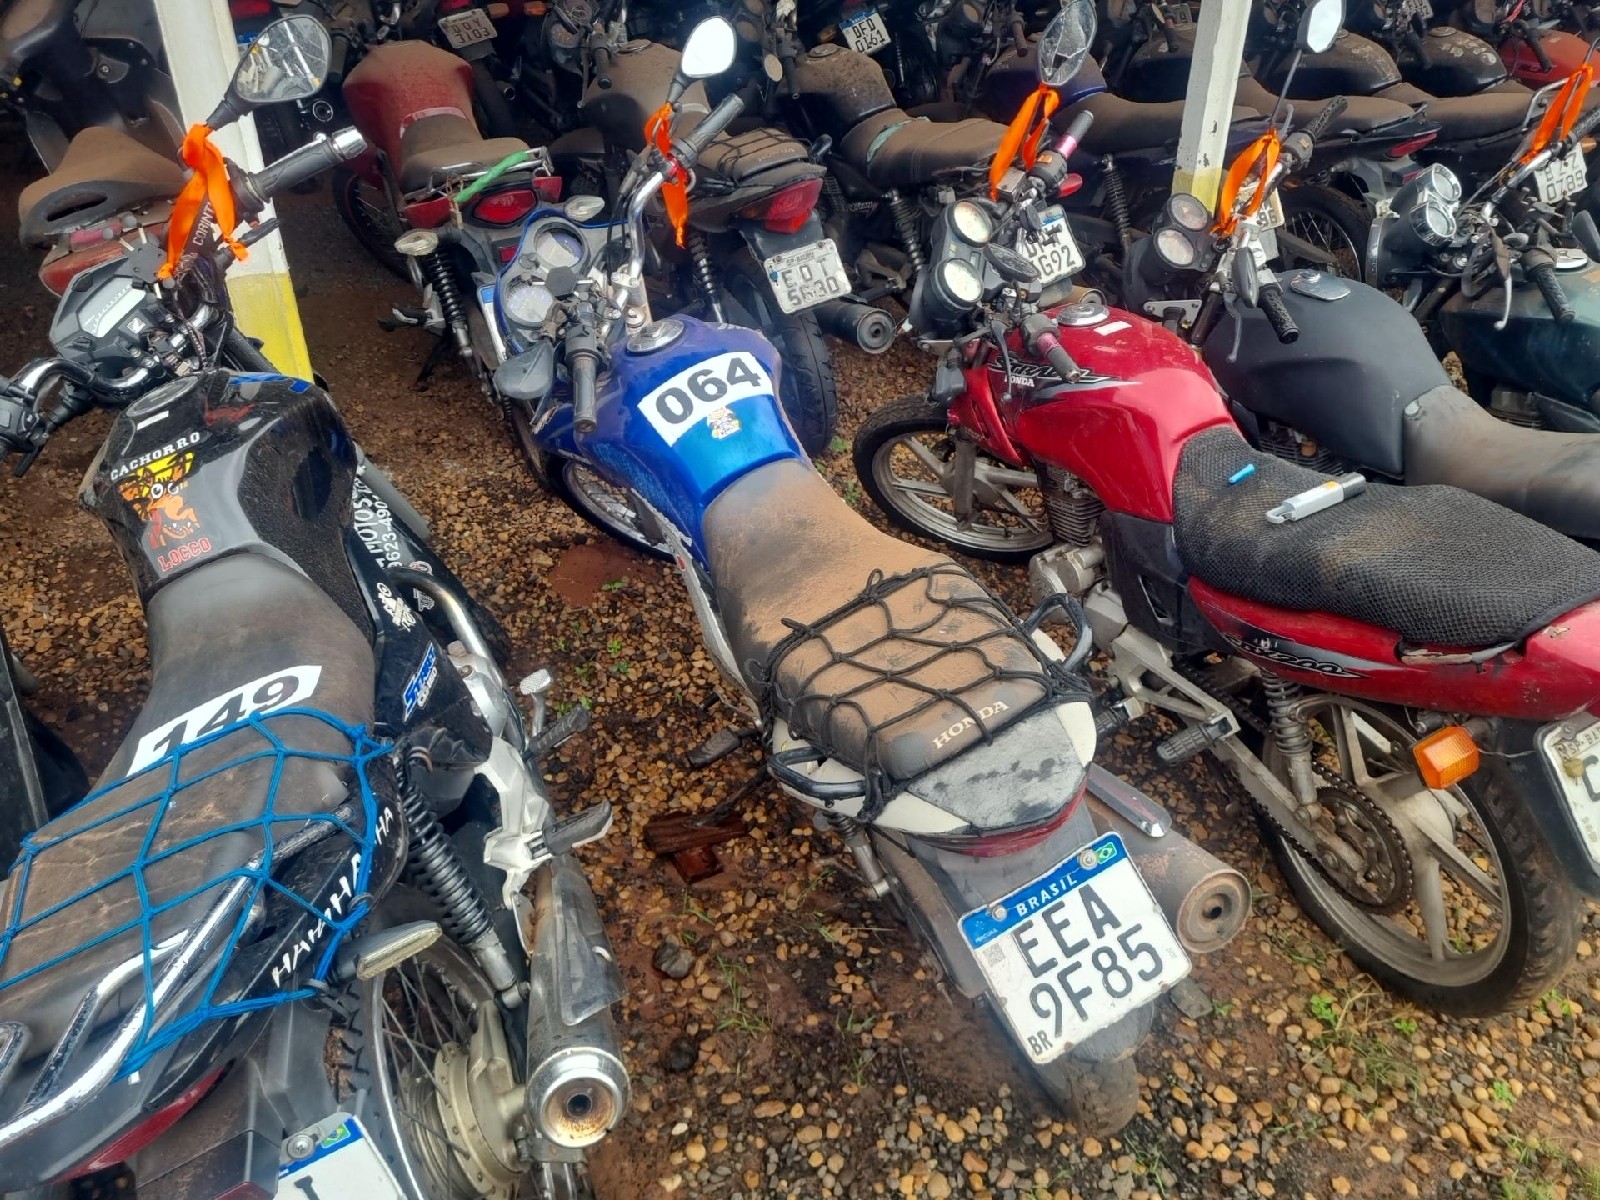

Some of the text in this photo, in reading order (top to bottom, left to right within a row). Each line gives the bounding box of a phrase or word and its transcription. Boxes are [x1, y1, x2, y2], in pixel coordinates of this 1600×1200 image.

[192, 201, 216, 246] CORINT
[656, 357, 762, 424] 064
[110, 432, 201, 481] CACHORRO
[158, 537, 212, 572] LOCCO
[153, 675, 300, 752] 149
[932, 701, 1010, 749] HONDA
[1016, 874, 1078, 917] BRASIL
[1012, 884, 1122, 978] EEA
[1029, 923, 1163, 1038] 9F85
[1027, 1030, 1053, 1056] BR
